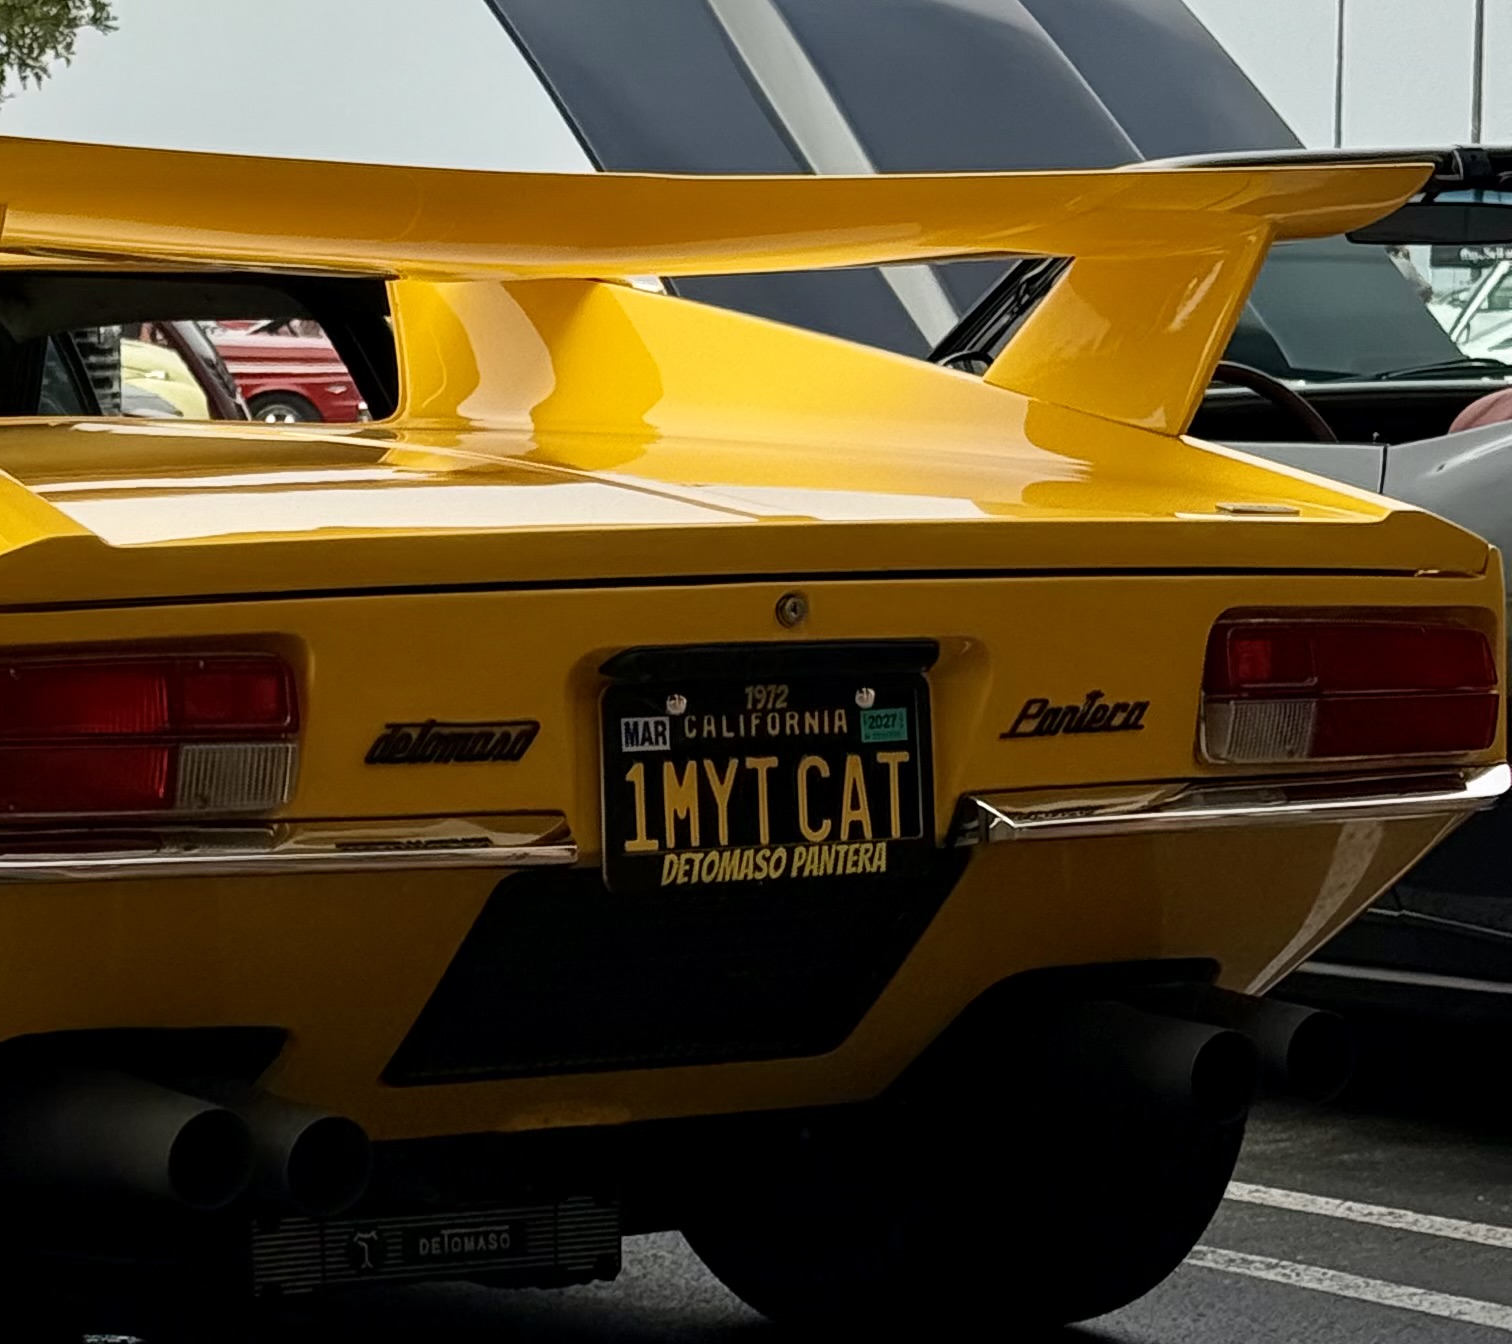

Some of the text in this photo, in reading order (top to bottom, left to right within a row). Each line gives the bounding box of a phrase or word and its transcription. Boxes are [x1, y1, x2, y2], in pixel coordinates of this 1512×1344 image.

[745, 685, 789, 710] 1972
[684, 709, 848, 738] CALIFORNIA
[868, 713, 897, 729] 2027
[999, 690, 1150, 739] Pantera
[624, 720, 667, 748] MAR
[624, 752, 910, 852] 1MYT CAT
[661, 842, 886, 887] DETOMASO PANTERA
